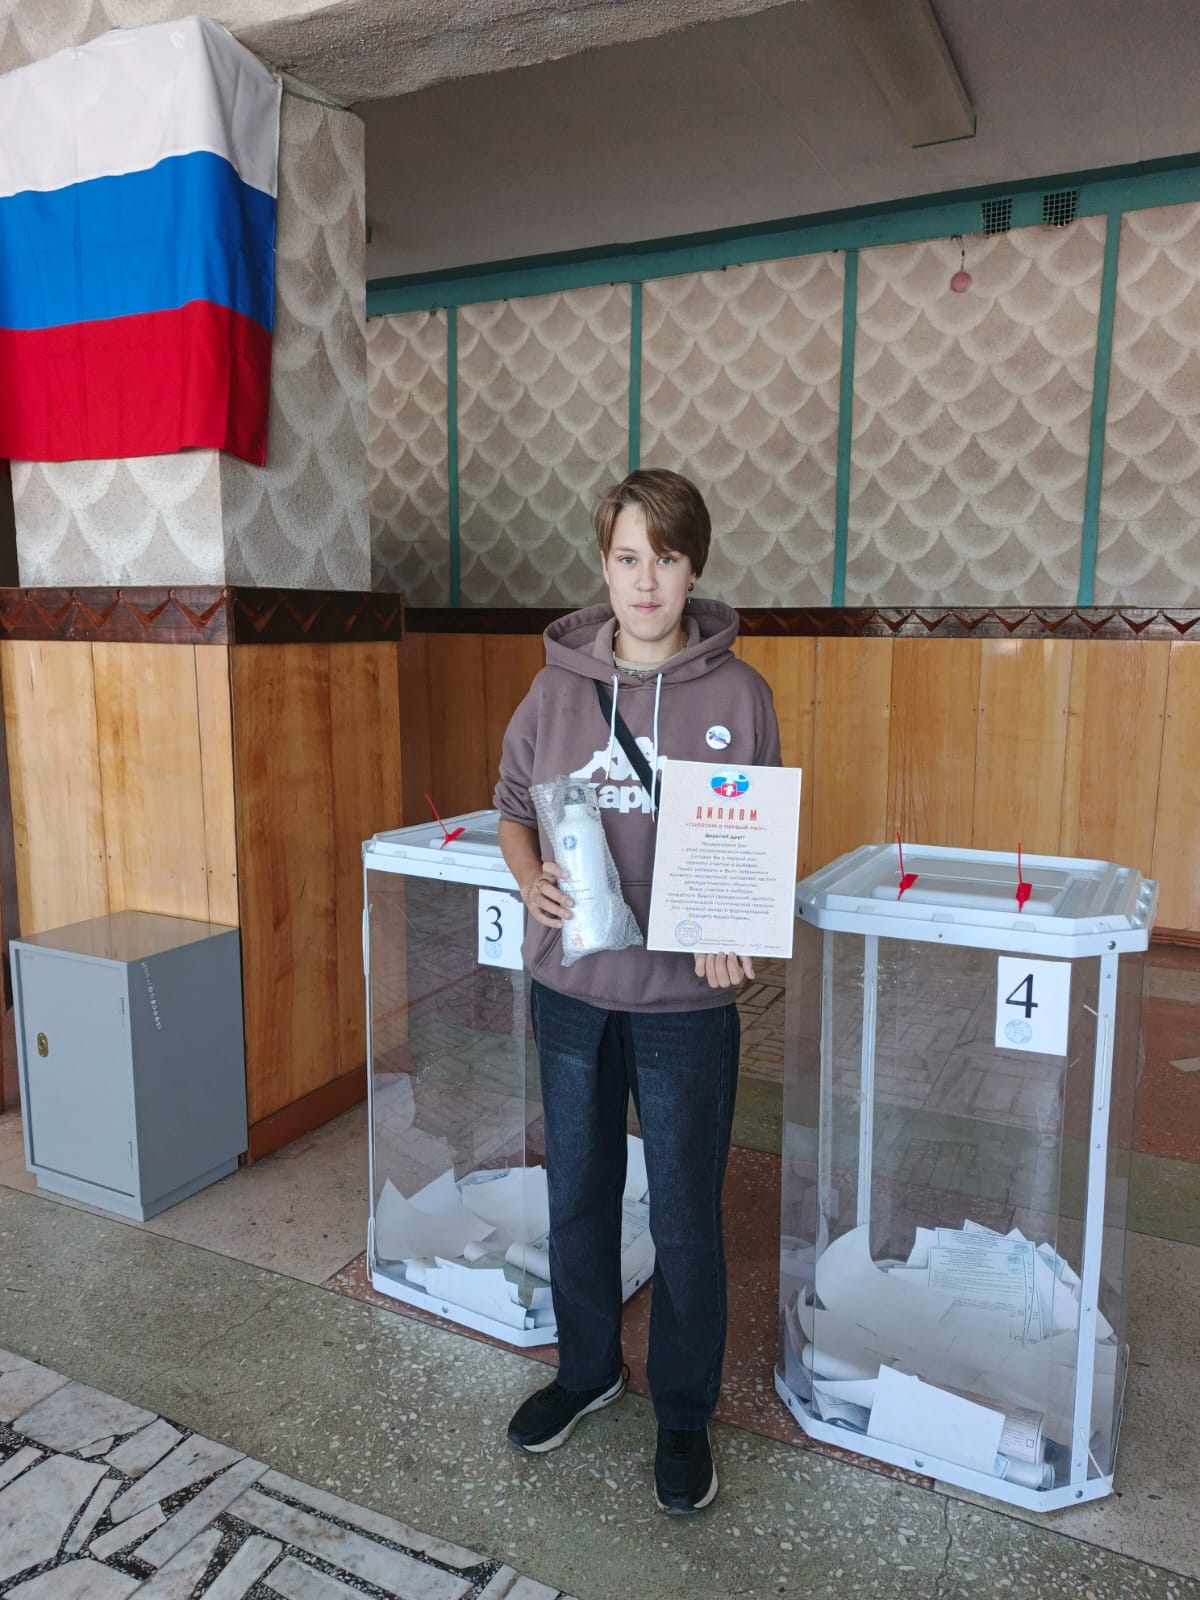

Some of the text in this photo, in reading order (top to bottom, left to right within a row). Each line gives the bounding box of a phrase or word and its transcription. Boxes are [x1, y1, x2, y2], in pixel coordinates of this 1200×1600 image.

[695, 805, 758, 821] ДИПЛОМ
[485, 905, 503, 942] 3
[1005, 974, 1039, 1019] 4
